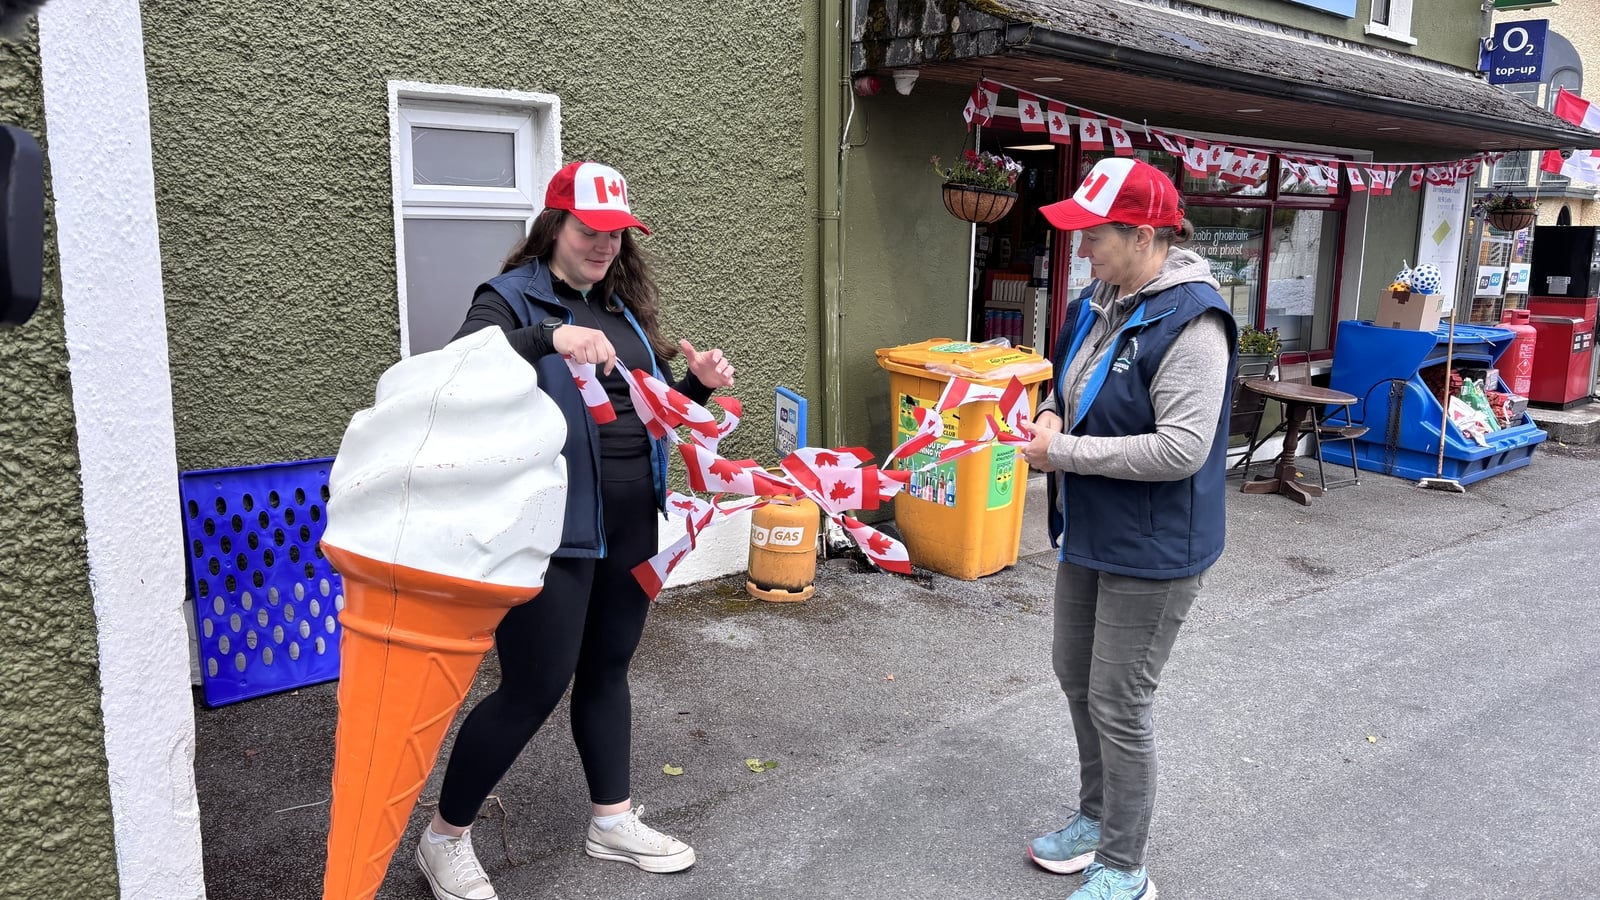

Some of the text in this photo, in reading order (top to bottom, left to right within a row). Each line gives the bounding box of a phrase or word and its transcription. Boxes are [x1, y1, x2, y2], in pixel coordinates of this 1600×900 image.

[1495, 65, 1536, 77] top-up
[943, 430, 957, 438] CLUB
[774, 531, 799, 542] GAS
